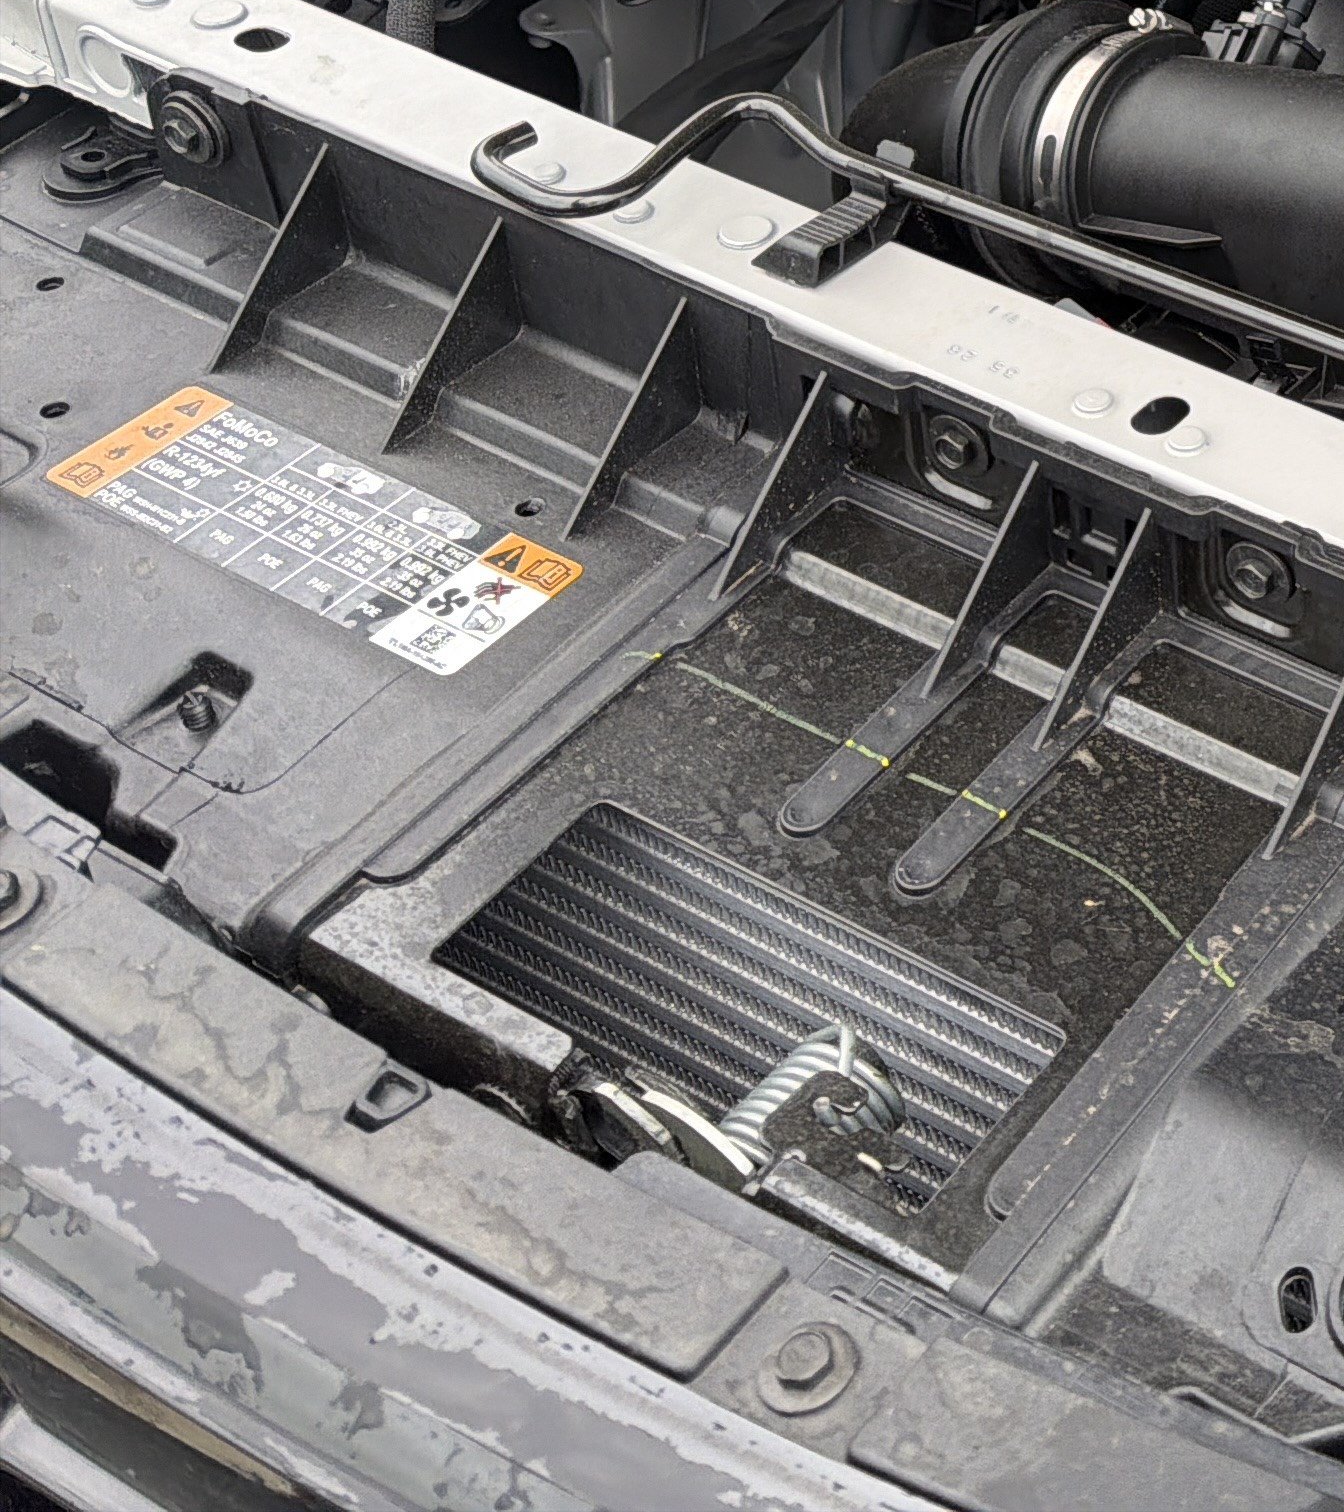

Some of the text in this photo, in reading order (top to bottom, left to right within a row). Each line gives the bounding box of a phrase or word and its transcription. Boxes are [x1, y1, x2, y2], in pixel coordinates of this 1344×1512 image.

[213, 412, 278, 447] FoMoCo
[141, 458, 187, 479] (GWP
[163, 445, 226, 478] R-1234yf
[106, 481, 137, 498] PAG
[93, 489, 125, 508] POE
[209, 529, 234, 544] PAG
[257, 553, 283, 569] POE
[380, 546, 397, 561] kg
[306, 577, 332, 592] PAG
[356, 601, 382, 617] POE
